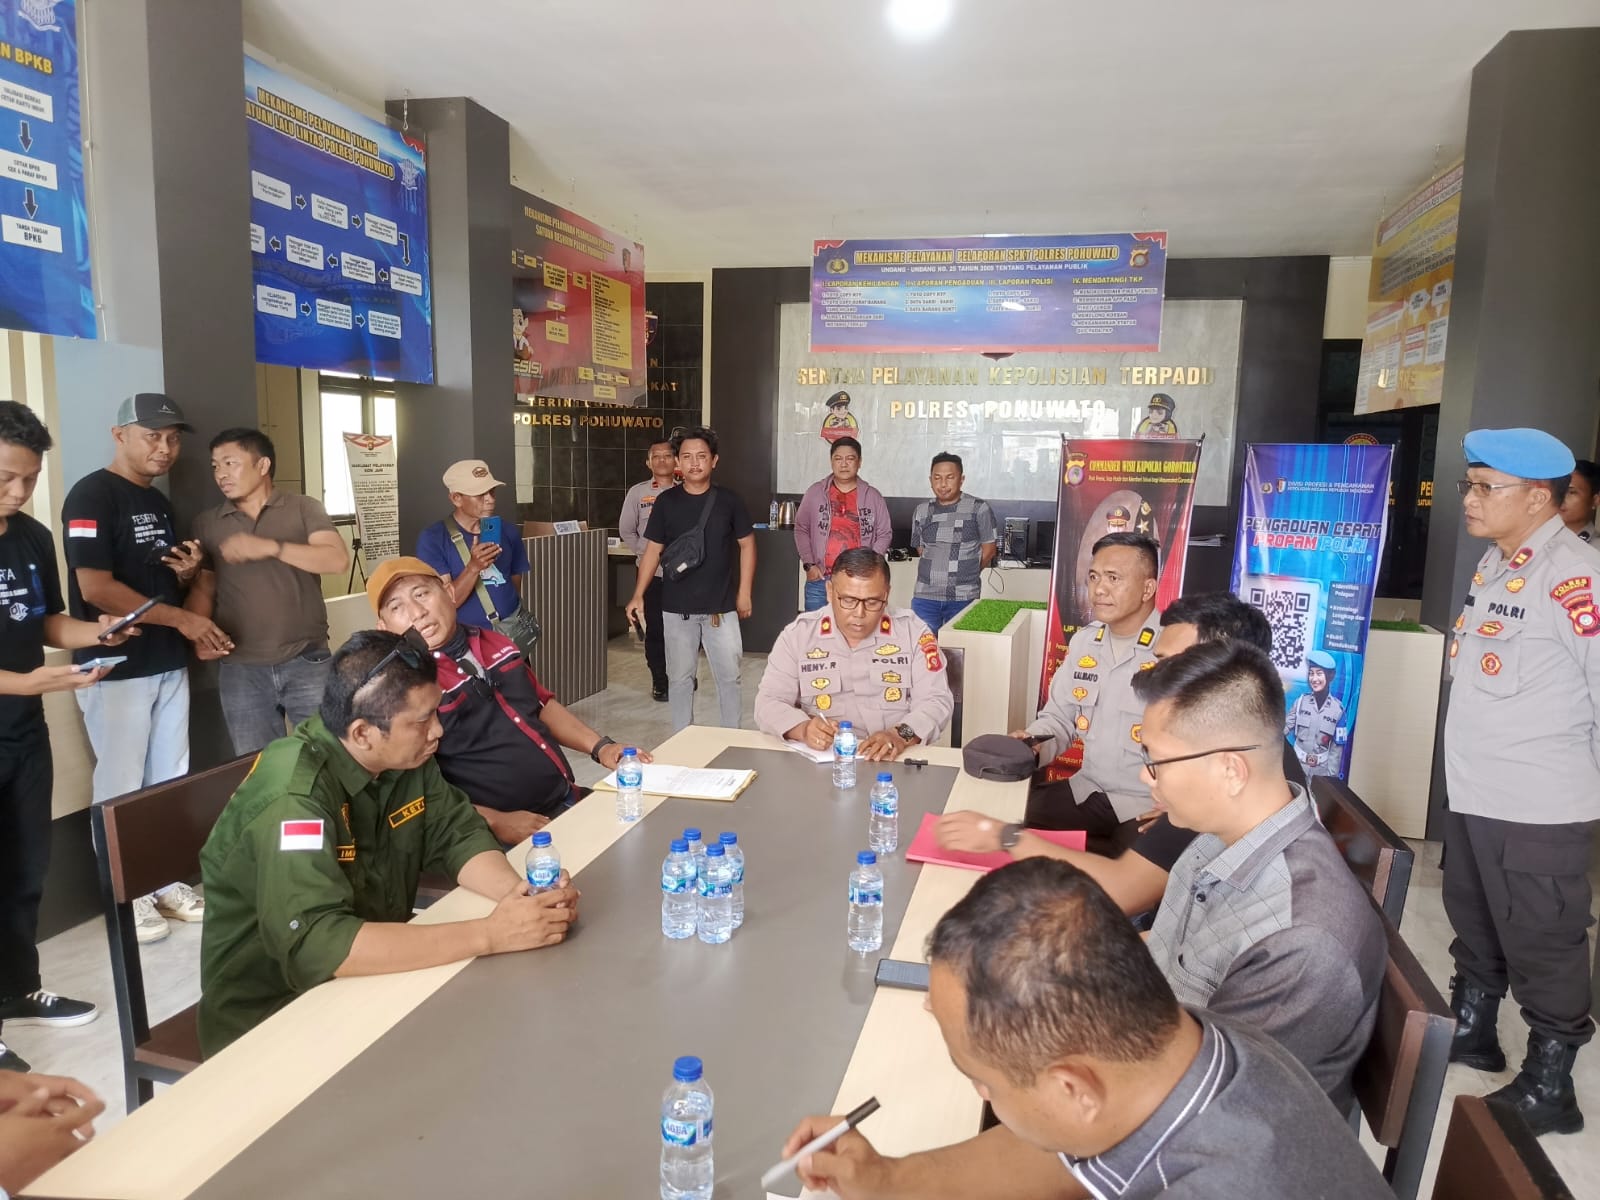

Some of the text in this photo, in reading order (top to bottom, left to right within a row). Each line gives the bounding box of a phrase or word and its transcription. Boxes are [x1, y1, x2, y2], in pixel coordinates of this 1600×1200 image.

[15, 47, 53, 75] BPKB
[257, 87, 378, 157] MEKANISME PELAYANAN TILANG
[273, 113, 295, 137] LALU
[295, 121, 324, 151] LINTAS
[324, 136, 354, 162] POLRES
[354, 150, 395, 179] POHUWATO
[23, 232, 42, 244] BPKB
[855, 246, 1118, 265] MEKANISME PELAYANAN PELAPORAN SPKT POLRES POHUWATO
[994, 264, 1024, 272] TENTANG
[1026, 263, 1062, 272] PELAYANAN
[1064, 262, 1088, 271] PUBLIK
[944, 279, 985, 287] PENGADUAN
[998, 278, 1031, 286] LAPORAN
[1082, 276, 1127, 284] MENDATANGI
[797, 366, 1215, 386] SENTRA PELAYANAN KEPOLISIAN TERPADU
[889, 400, 1106, 420] POLRES POHUWATO
[513, 413, 664, 428] POLRES POHUWATO
[1089, 460, 1120, 472] COMMANDER
[1136, 460, 1162, 473] KAPOLDA
[1162, 461, 1196, 474] GORONTALO
[1244, 517, 1382, 538] PENGADUAN CEPAT
[1253, 532, 1369, 553] PROPAM POLRI
[1553, 578, 1588, 597] POLRES
[1332, 612, 1354, 621] Lengkap
[1487, 602, 1526, 620] POLRI
[871, 656, 909, 665] POLRI
[665, 1123, 689, 1136] AQUA
